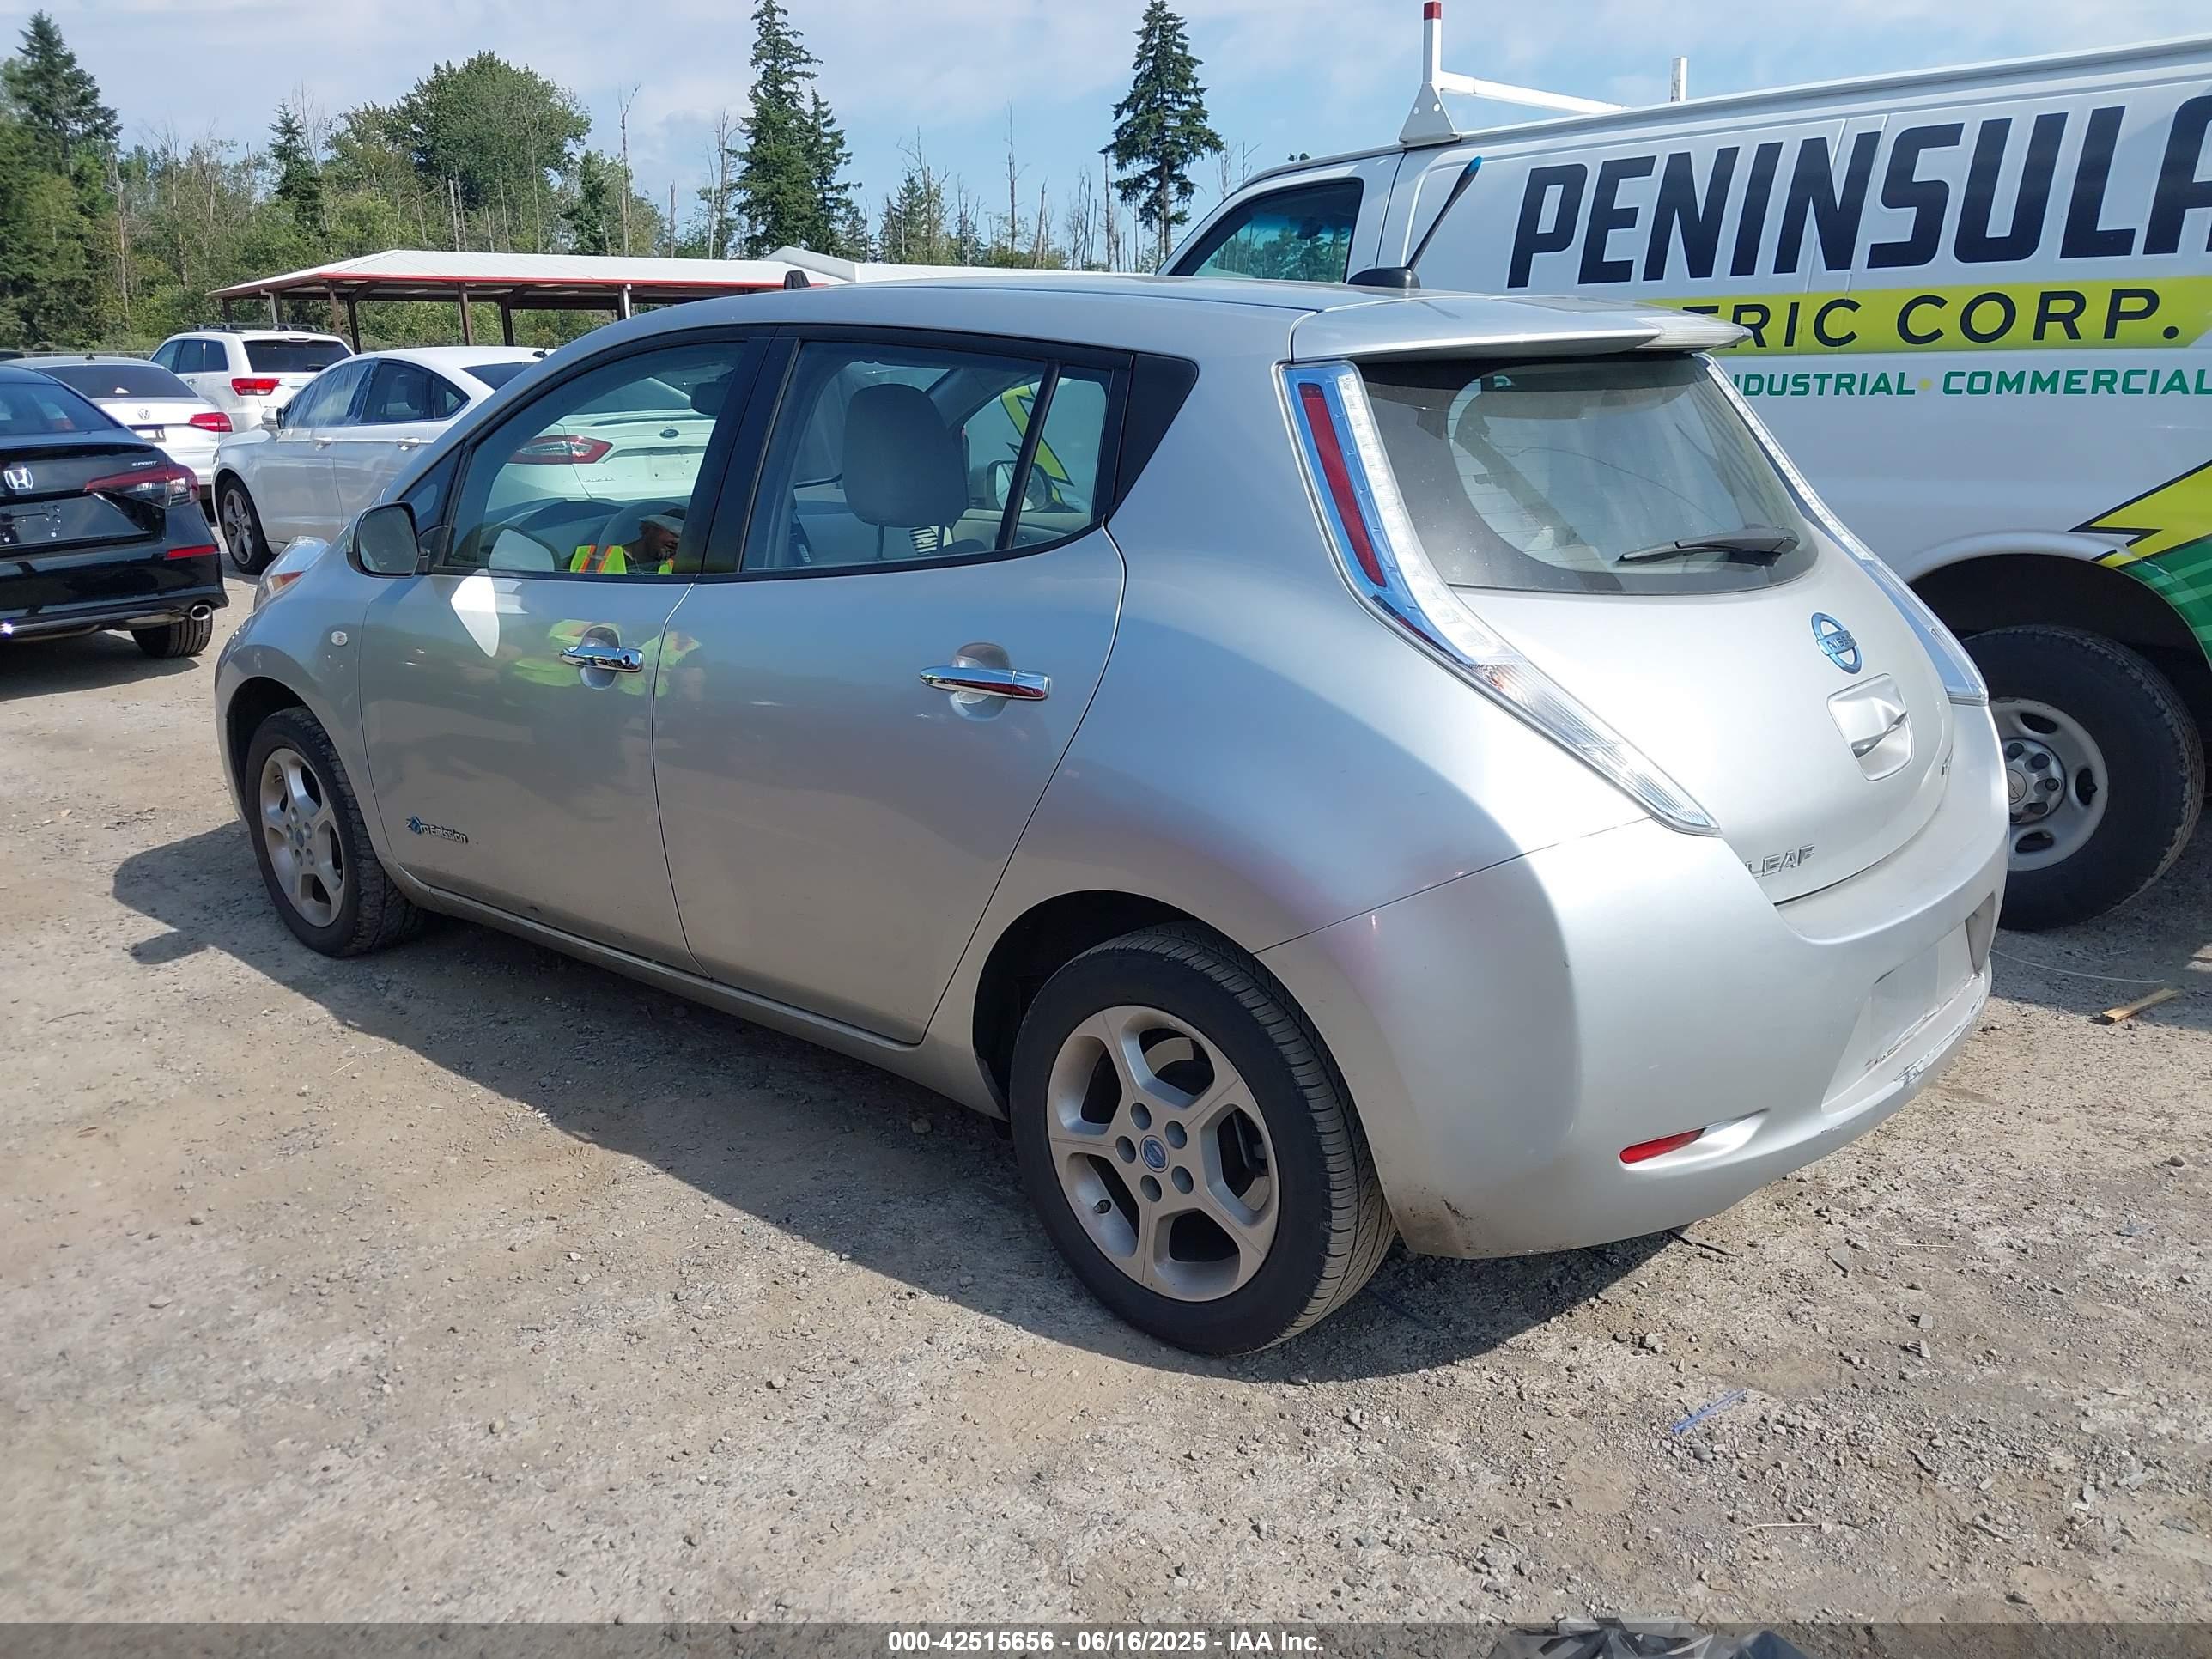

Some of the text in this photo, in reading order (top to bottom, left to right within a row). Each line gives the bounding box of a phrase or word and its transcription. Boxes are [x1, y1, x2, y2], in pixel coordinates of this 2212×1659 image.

[1507, 95, 2212, 289] PENINSULA
[1897, 288, 2179, 345] CORP.
[1942, 369, 2212, 396] COMMERCIAL
[1744, 844, 1814, 879] LEAF
